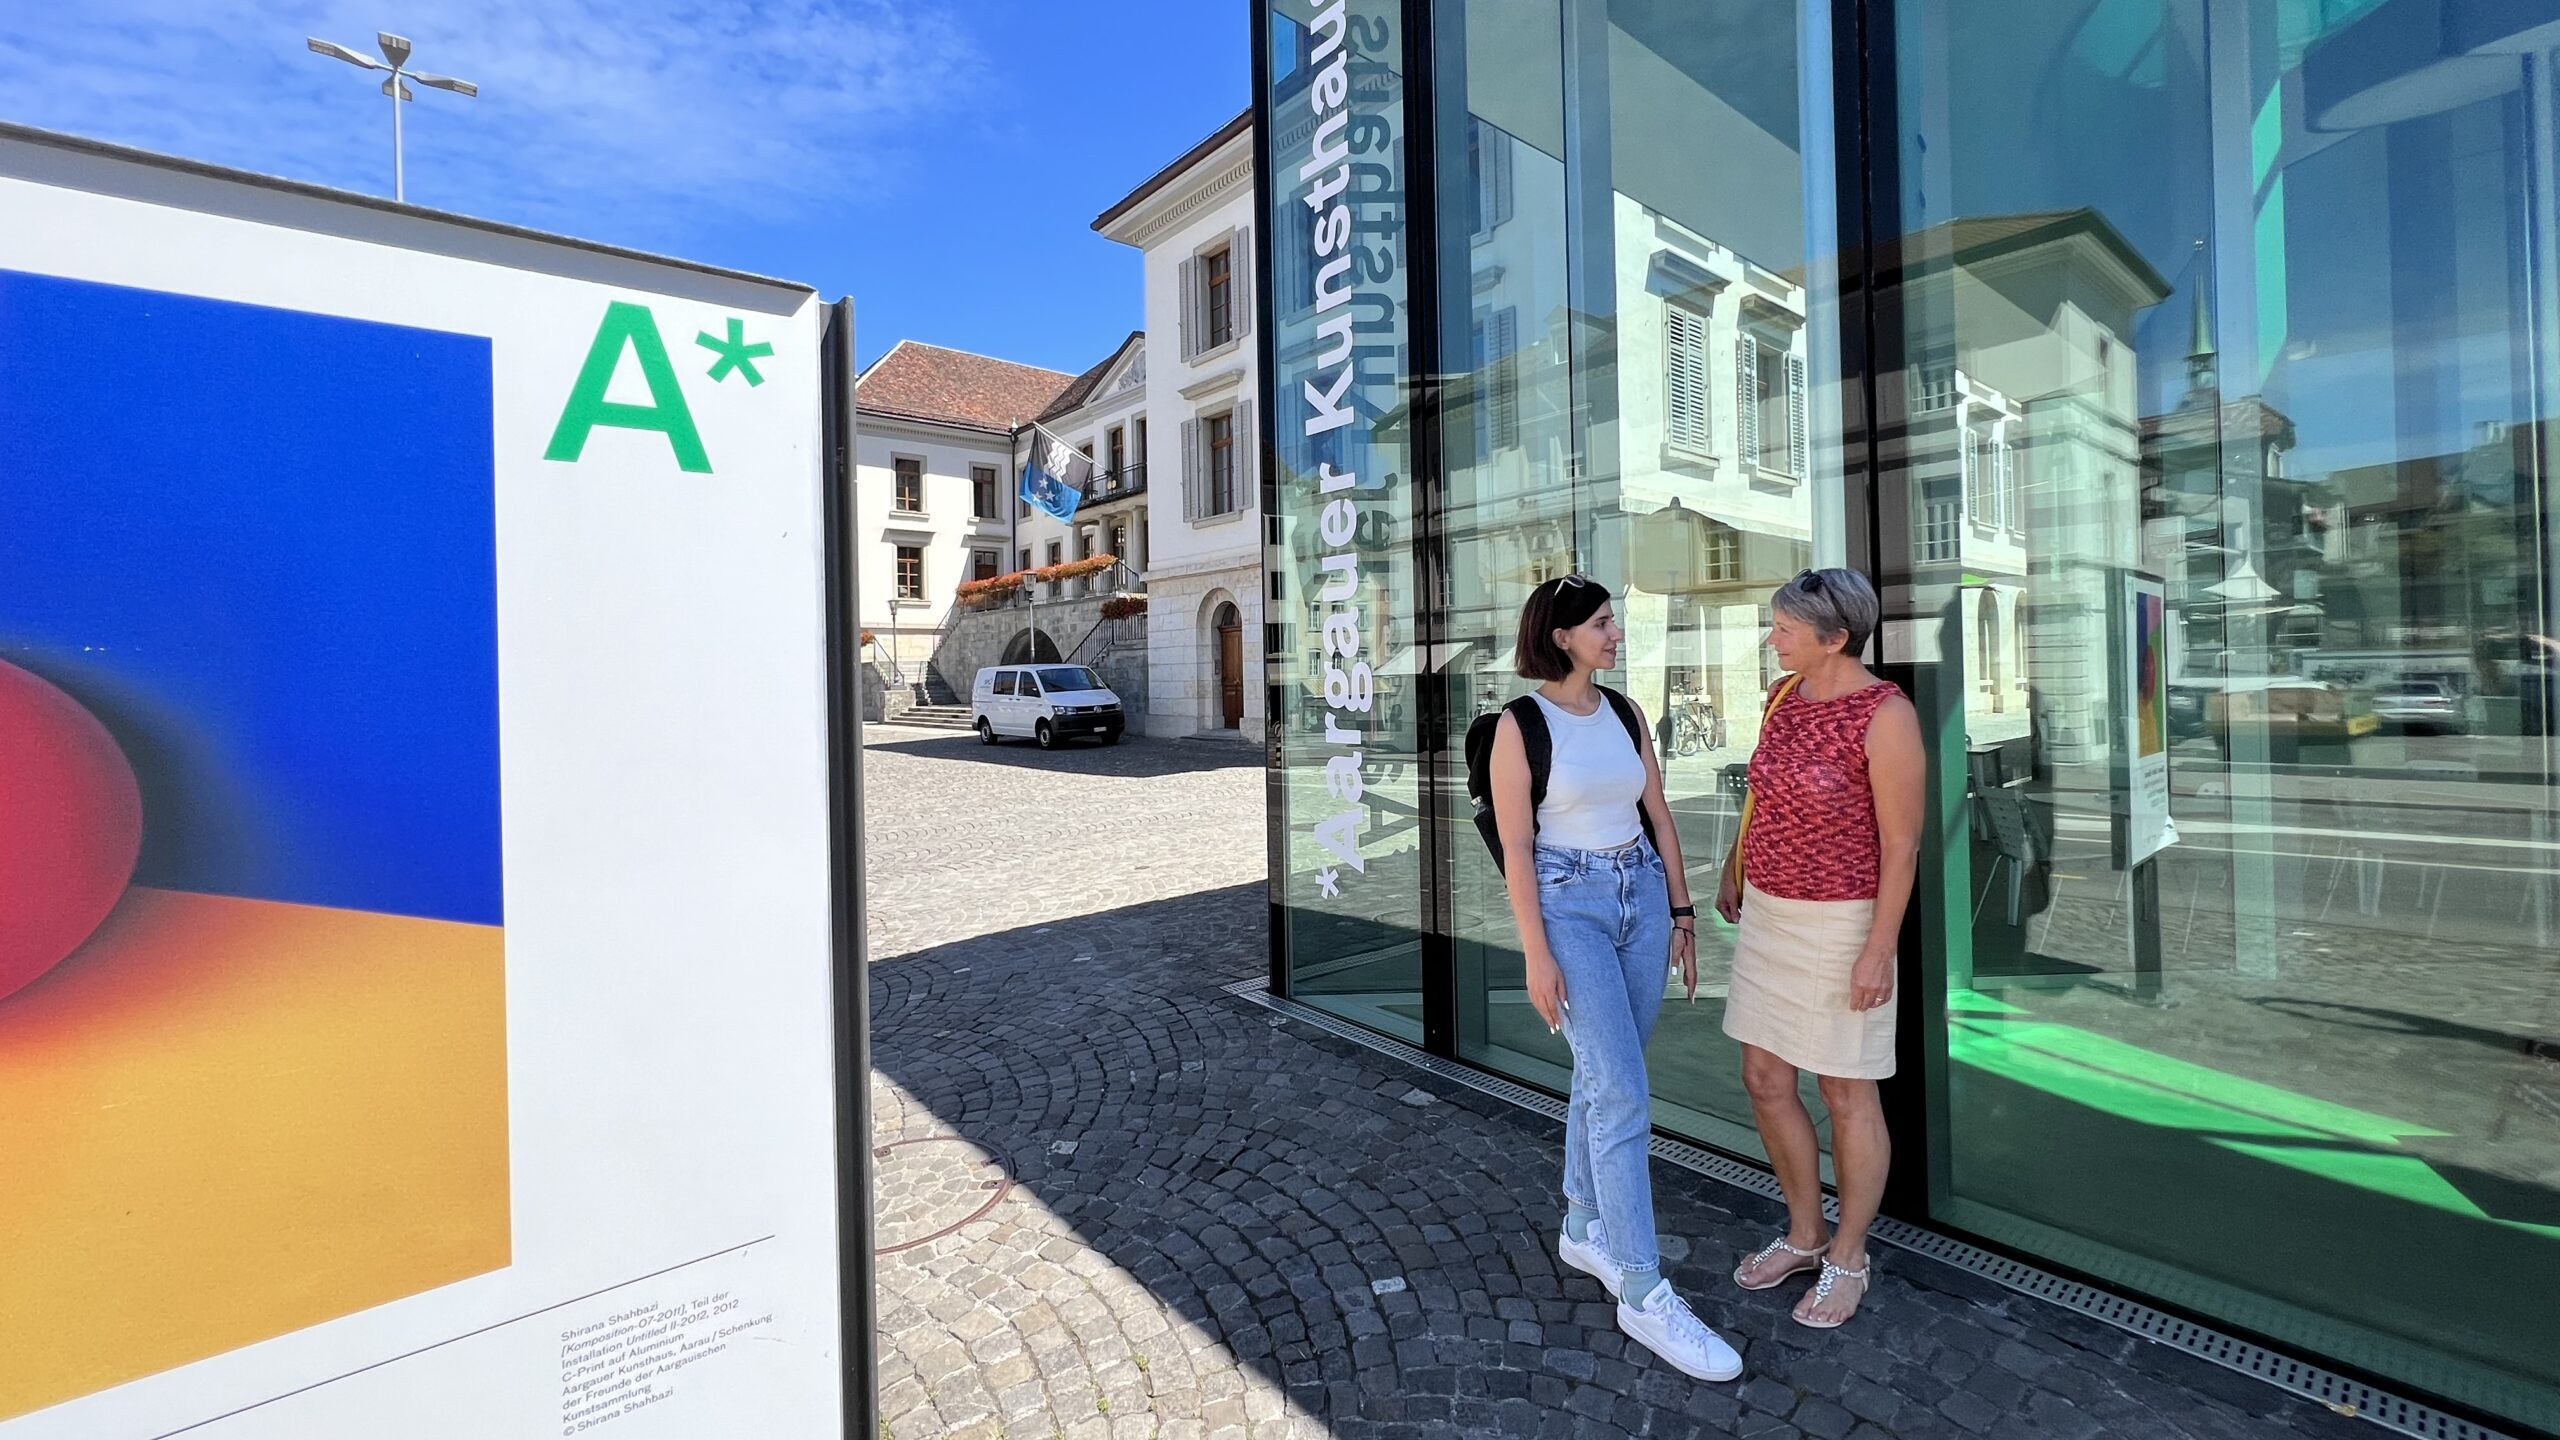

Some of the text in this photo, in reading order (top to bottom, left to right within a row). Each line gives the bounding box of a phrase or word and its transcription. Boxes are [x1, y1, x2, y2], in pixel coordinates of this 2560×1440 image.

[561, 1301, 658, 1342] Shirana Shahbazi
[691, 1297, 709, 1310] Teil
[712, 1291, 729, 1303] der
[562, 1343, 622, 1369] Installation
[627, 1325, 666, 1345] Untitled
[713, 1299, 739, 1315] 2012
[562, 1333, 685, 1382] C-Print auf Aluminium
[562, 1372, 615, 1396] Aargauer
[619, 1350, 677, 1375] Kunsthaus,
[563, 1343, 726, 1410] der Freunde der Aargauischen
[563, 1384, 652, 1423] Kunstsammlung
[577, 1410, 620, 1431] Shirana
[624, 1386, 673, 1413] Shahbazi
